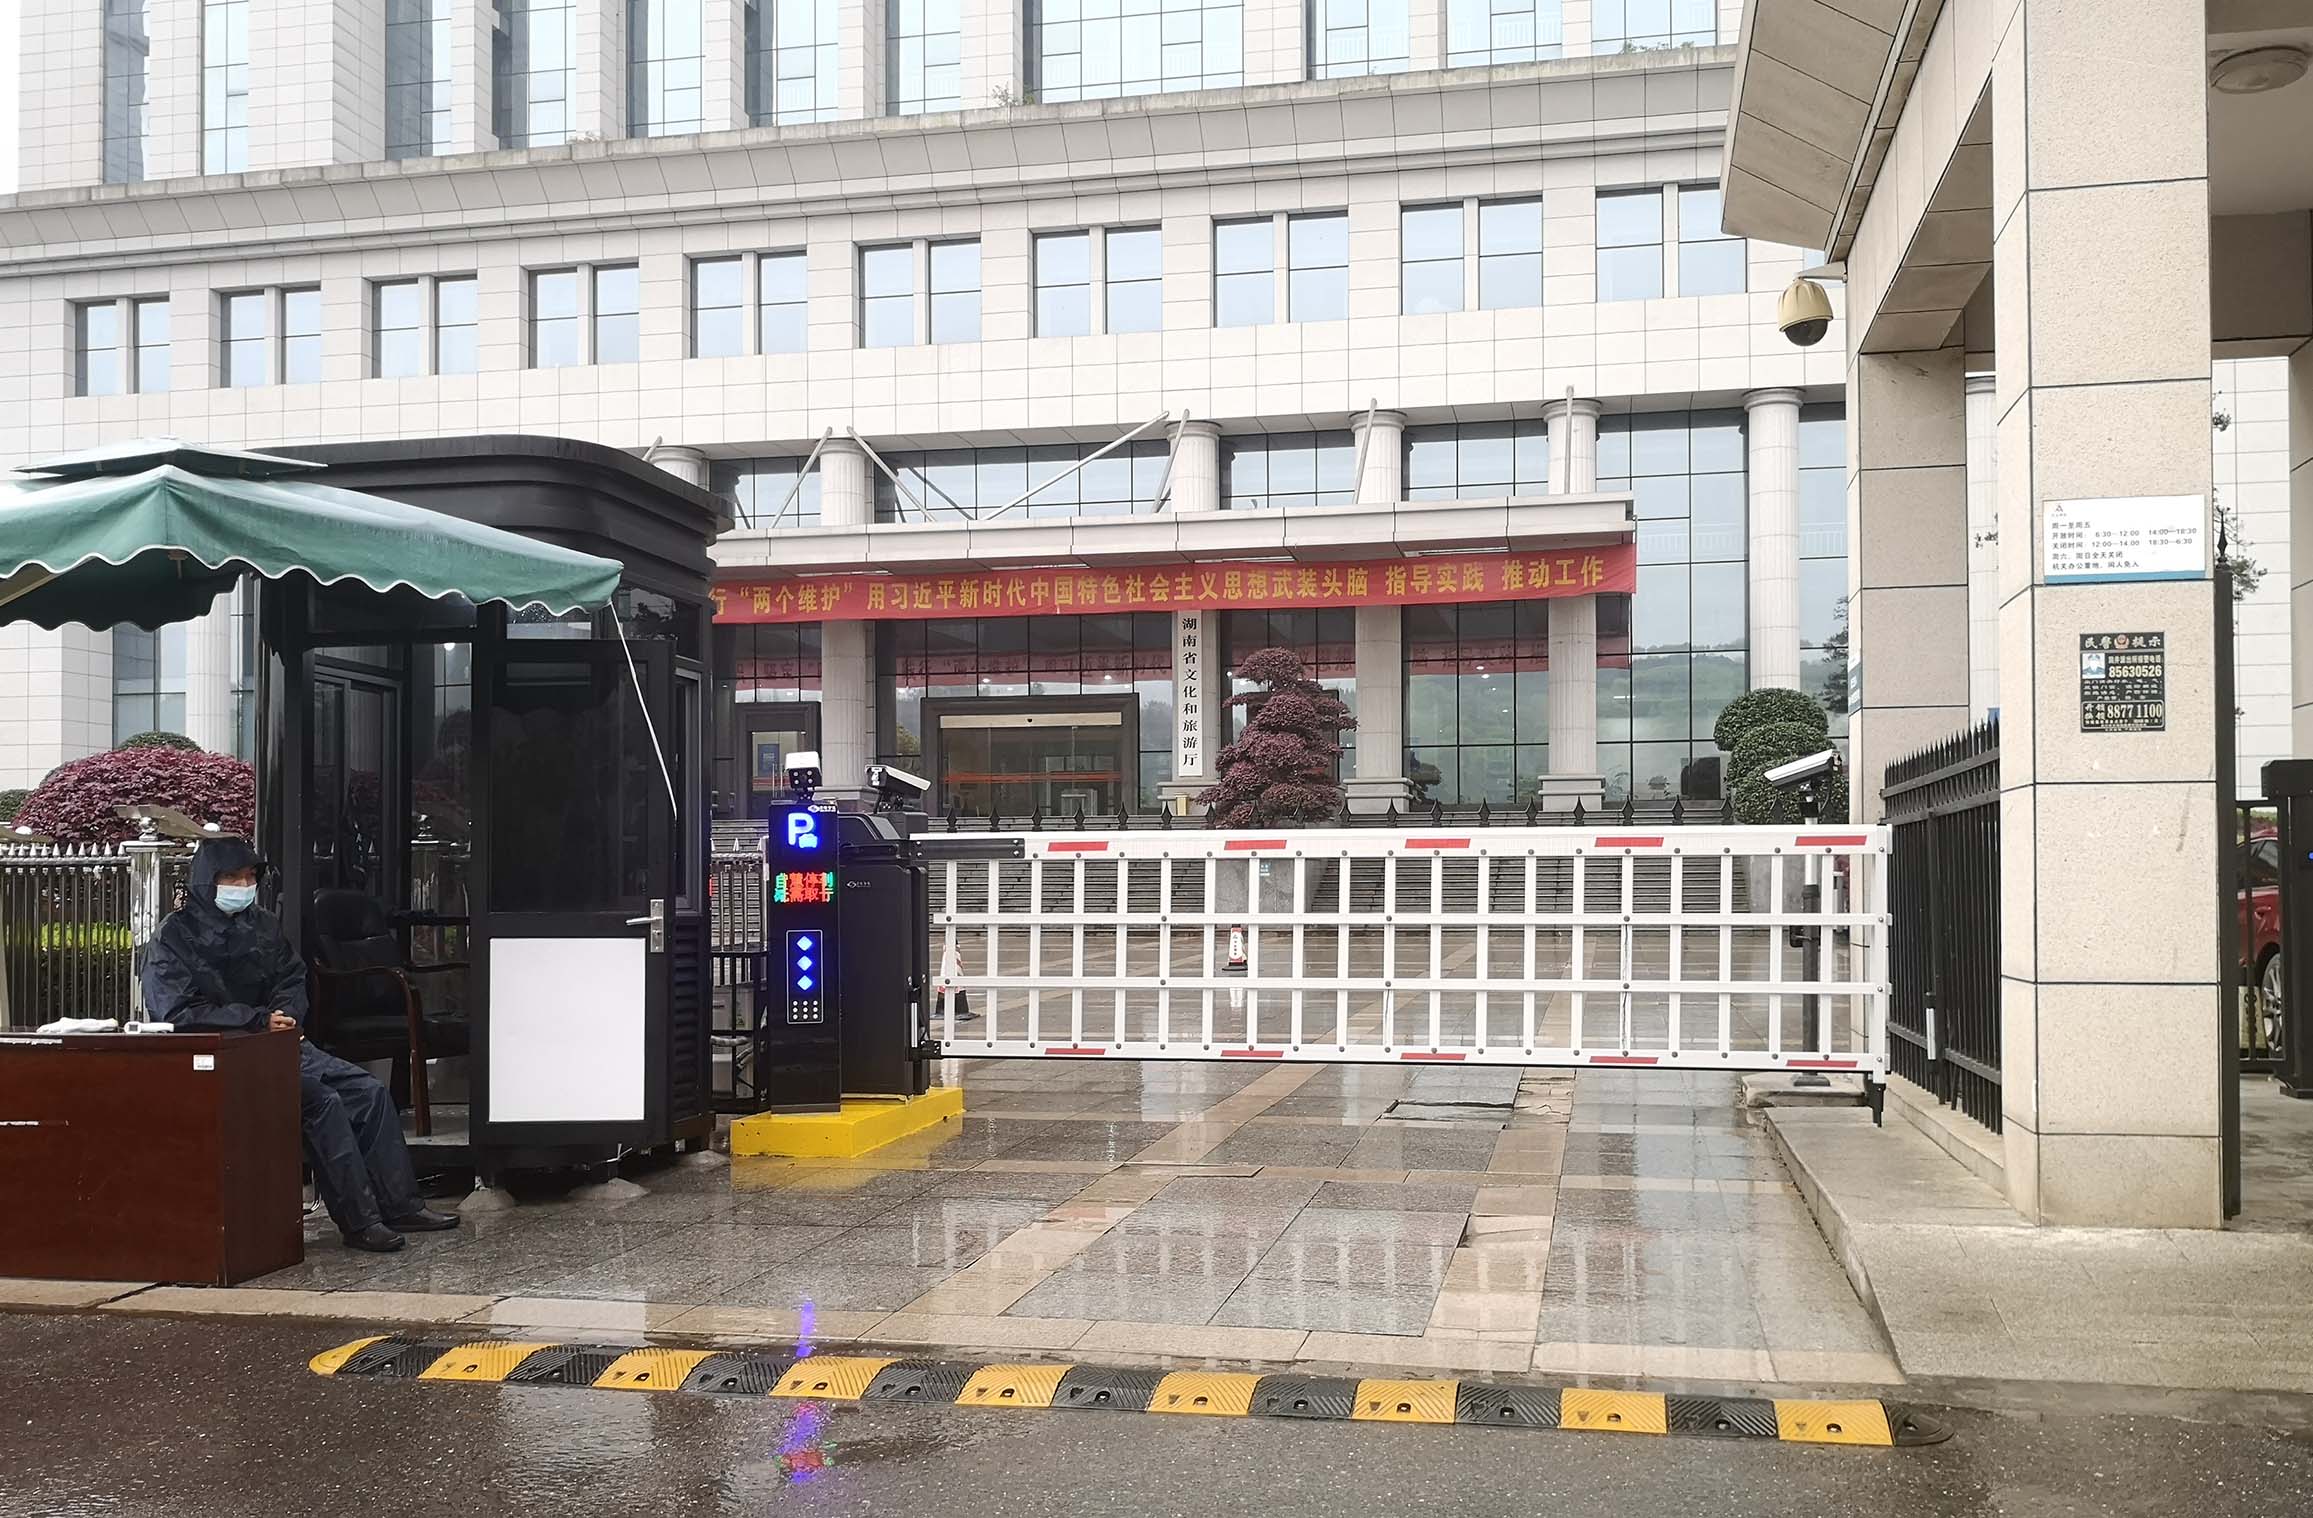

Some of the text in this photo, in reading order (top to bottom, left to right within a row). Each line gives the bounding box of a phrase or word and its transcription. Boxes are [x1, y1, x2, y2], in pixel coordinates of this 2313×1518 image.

[1385, 563, 1485, 597] 指导实践
[1501, 555, 1605, 592] 推动工作
[1182, 617, 1198, 767] 湖南省文化和旅游厅
[2108, 665, 2162, 678] 85630526
